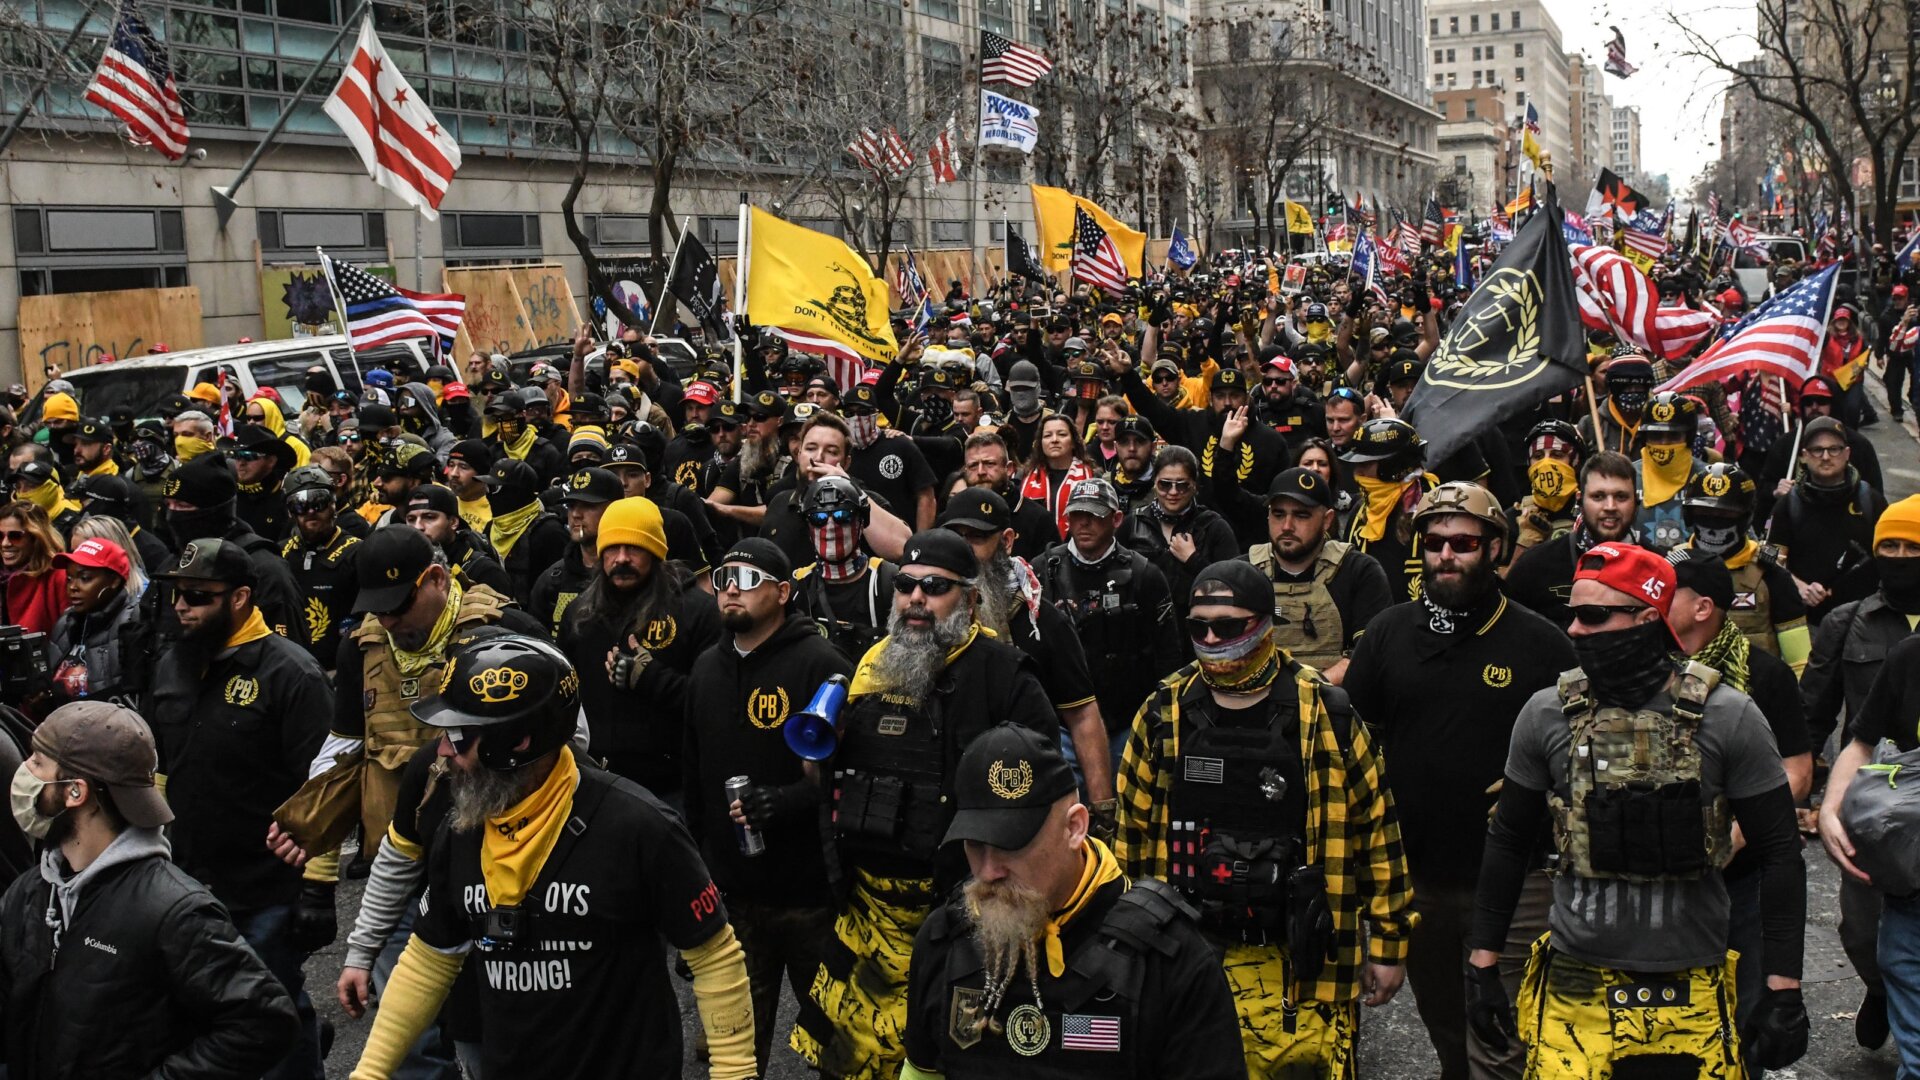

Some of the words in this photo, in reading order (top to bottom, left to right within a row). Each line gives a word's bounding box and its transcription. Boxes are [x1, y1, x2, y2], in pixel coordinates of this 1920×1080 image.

[1403, 362, 1412, 374] P
[1657, 405, 1669, 417] PB
[1539, 471, 1554, 489] PB
[1709, 477, 1722, 490] PB
[1641, 577, 1665, 600] 45
[1490, 666, 1506, 682] PB
[231, 678, 253, 700] PB
[759, 694, 778, 719] PB
[881, 693, 905, 705] PROUD
[1001, 768, 1021, 787] PB
[544, 881, 591, 916] OYS
[89, 938, 118, 955] Columbia
[485, 958, 572, 992] WRONG!
[1022, 1020, 1034, 1035] PB
